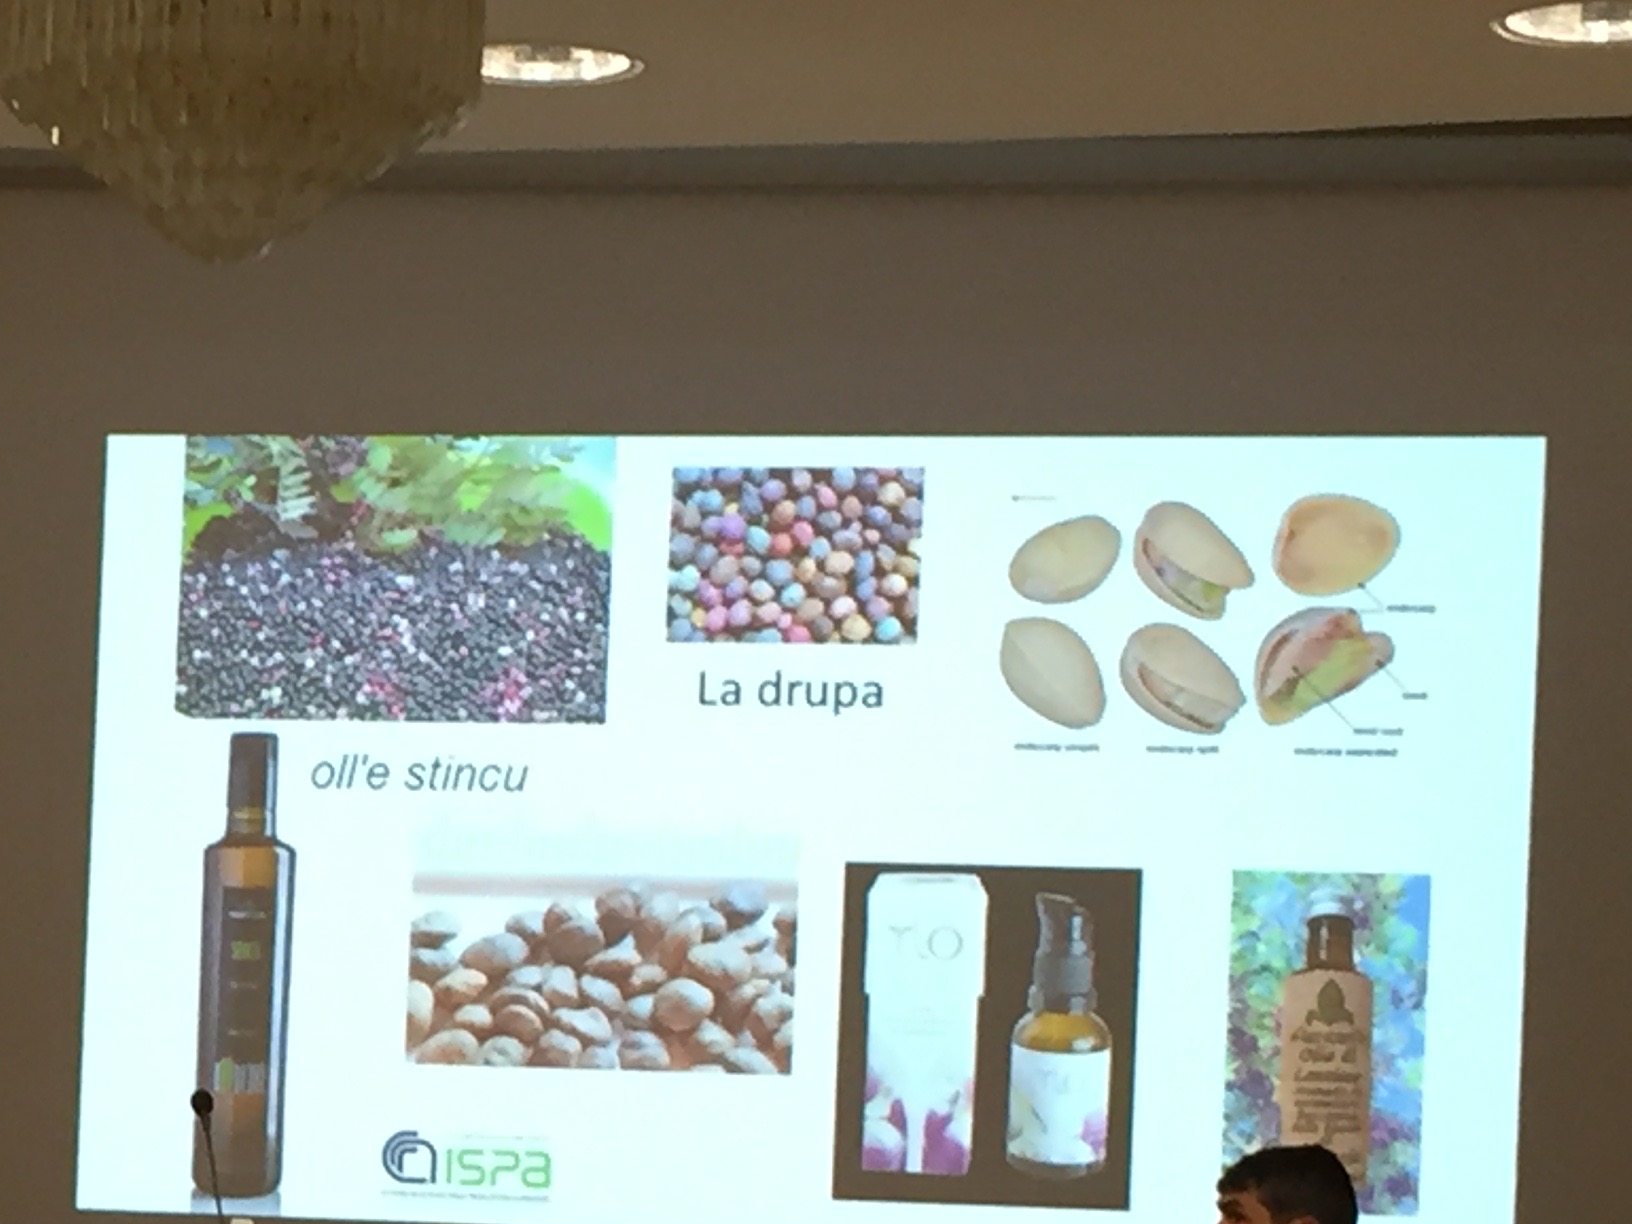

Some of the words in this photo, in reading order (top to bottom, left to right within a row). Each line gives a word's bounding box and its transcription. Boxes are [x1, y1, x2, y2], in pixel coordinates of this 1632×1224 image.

[698, 669, 742, 707] La
[757, 669, 885, 717] drupa
[309, 753, 391, 791] oll'e
[402, 755, 529, 793] stincu
